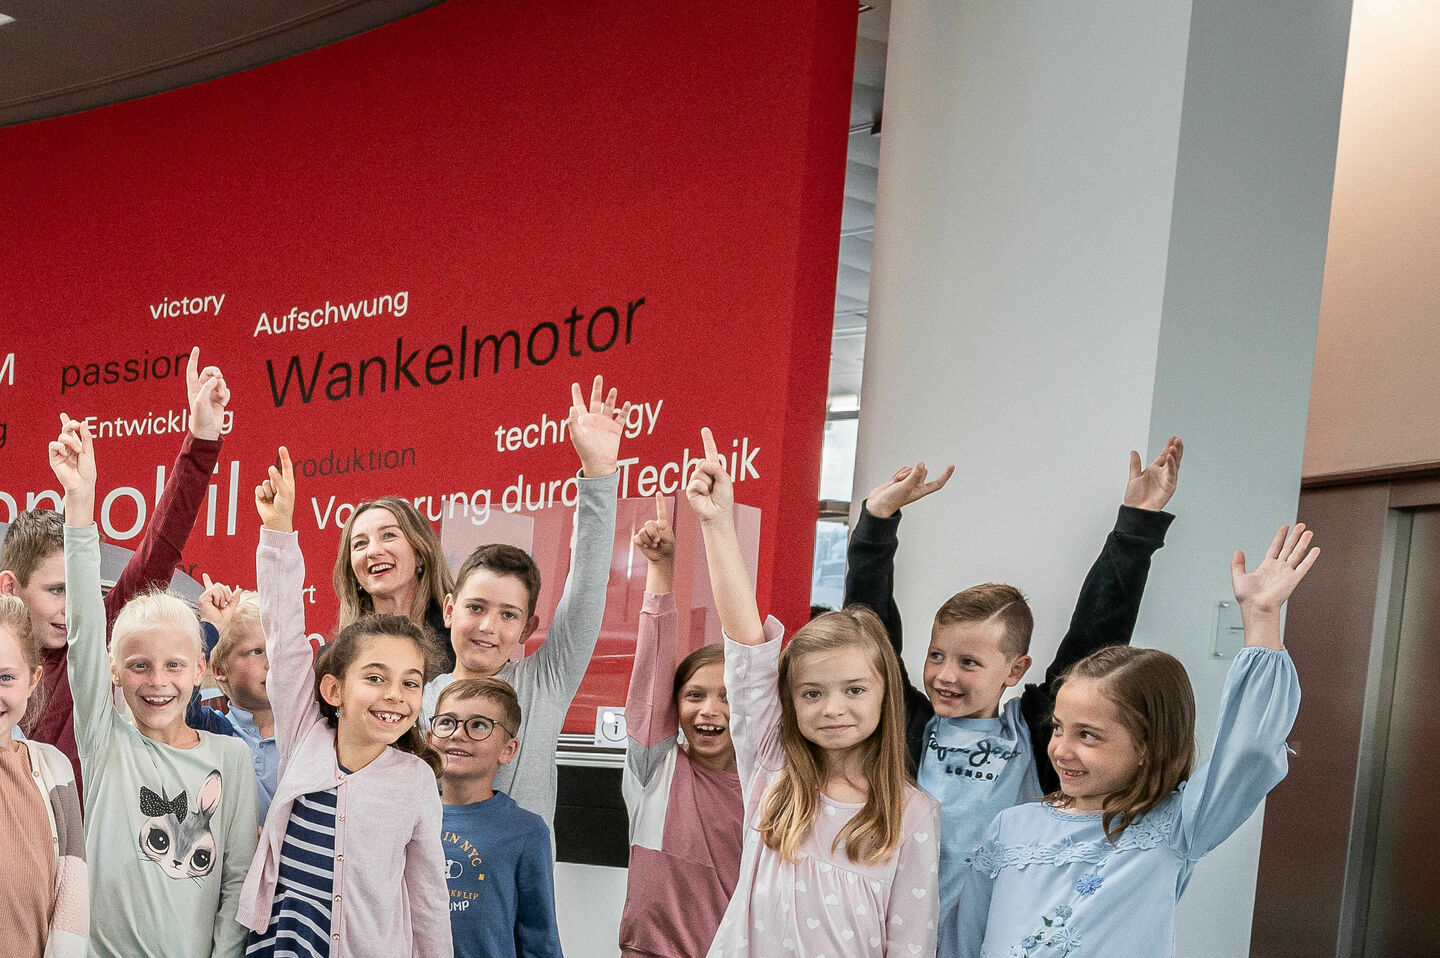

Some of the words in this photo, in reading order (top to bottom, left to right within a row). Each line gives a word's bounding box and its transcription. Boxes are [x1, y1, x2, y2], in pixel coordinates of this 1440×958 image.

[149, 293, 226, 321] victory
[253, 290, 410, 337] Aufschwung
[265, 296, 646, 408] Wankelmotor
[85, 408, 234, 439] Entwicklg
[494, 399, 664, 453] techgy
[311, 488, 492, 530] Vorung
[501, 474, 579, 514] durc
[617, 437, 760, 500] Techik
[442, 831, 461, 844] IN
[459, 840, 482, 867] NYC
